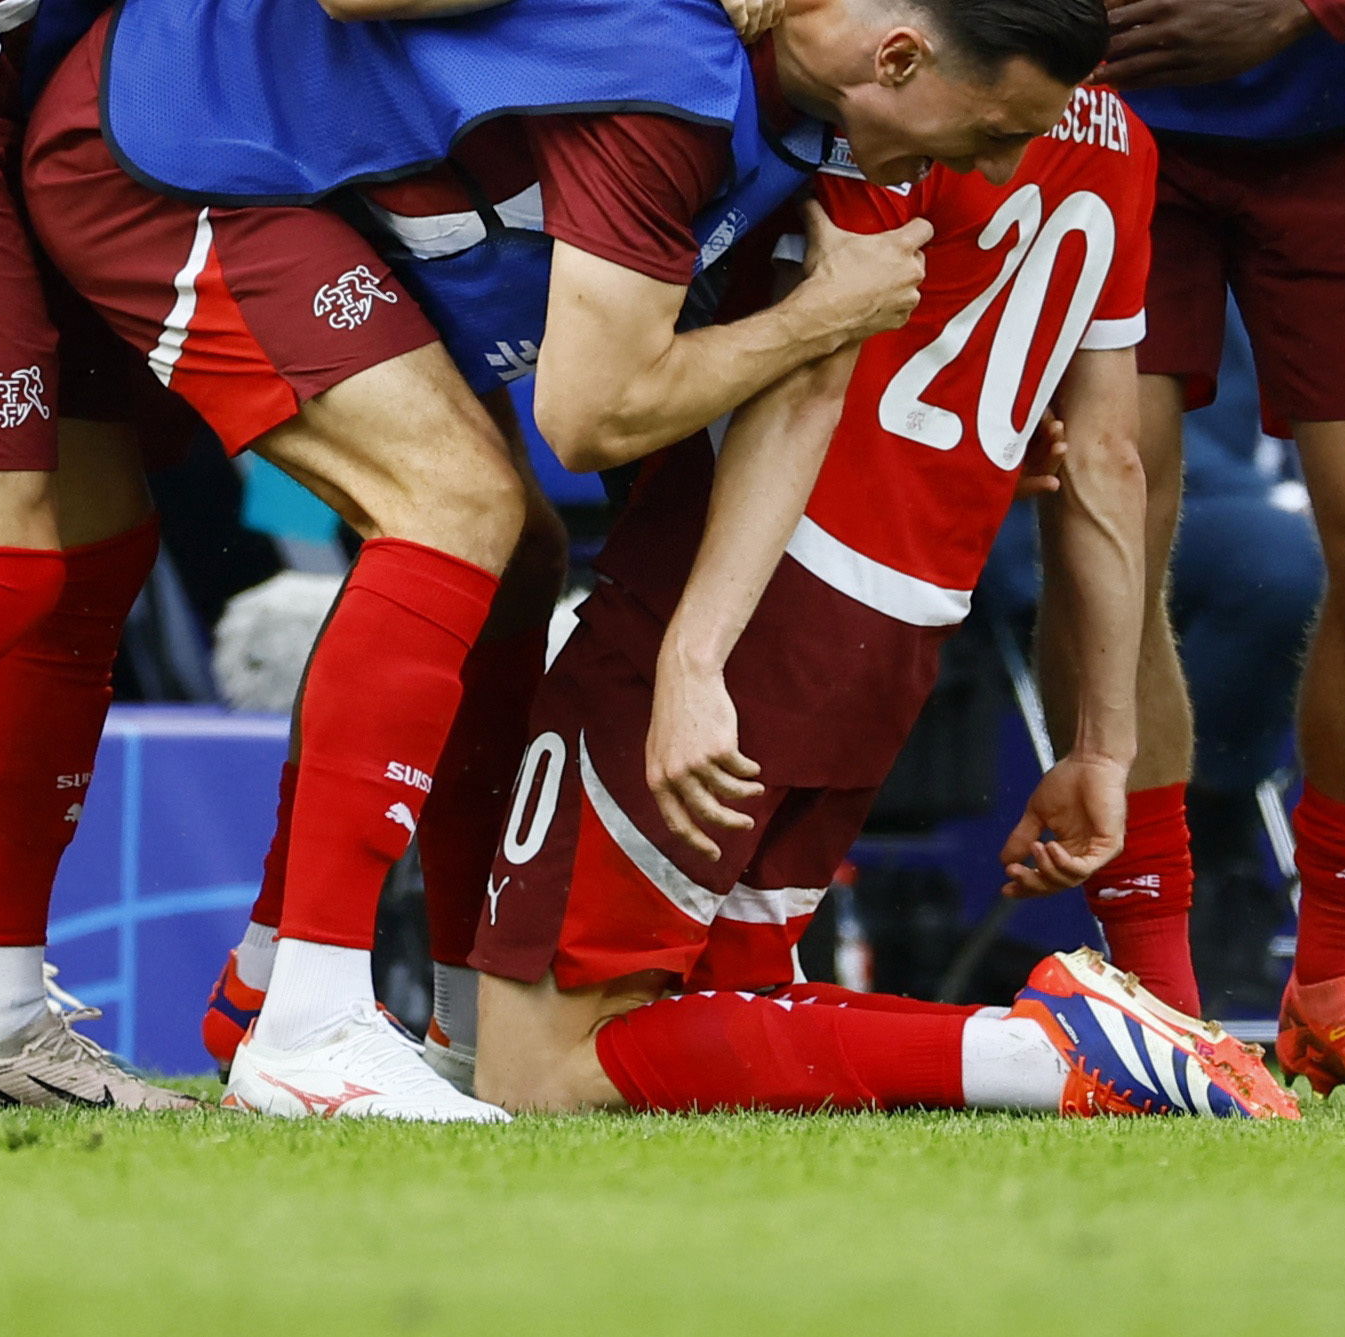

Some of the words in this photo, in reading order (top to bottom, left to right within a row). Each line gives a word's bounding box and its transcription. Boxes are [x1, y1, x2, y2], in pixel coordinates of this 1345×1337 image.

[878, 183, 1116, 471] 20
[384, 761, 433, 794] SUIS
[503, 731, 567, 865] 0
